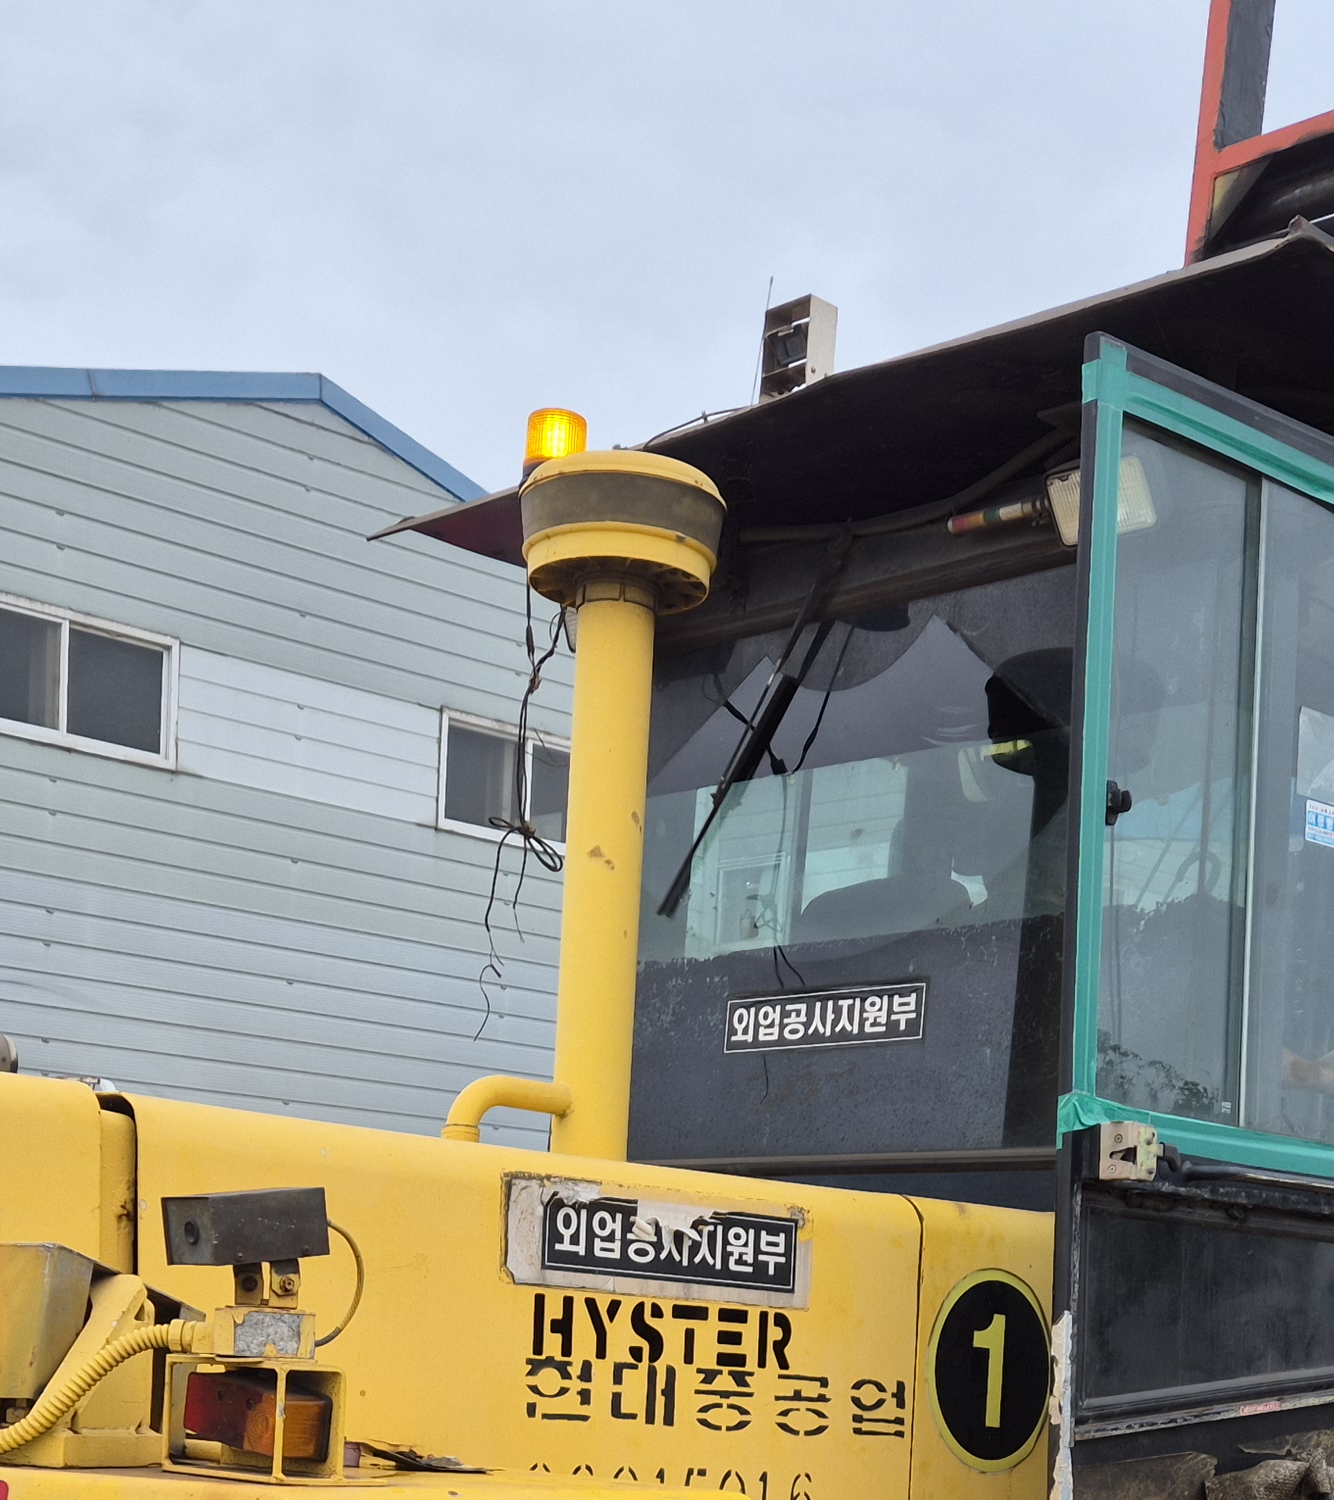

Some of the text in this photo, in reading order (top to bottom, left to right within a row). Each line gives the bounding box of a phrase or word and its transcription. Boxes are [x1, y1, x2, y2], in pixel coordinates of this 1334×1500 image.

[730, 991, 917, 1044] 외업공사지원부
[531, 1292, 793, 1371] HYSTER
[971, 1312, 1008, 1428] 1
[524, 1355, 906, 1438] 현대중공업
